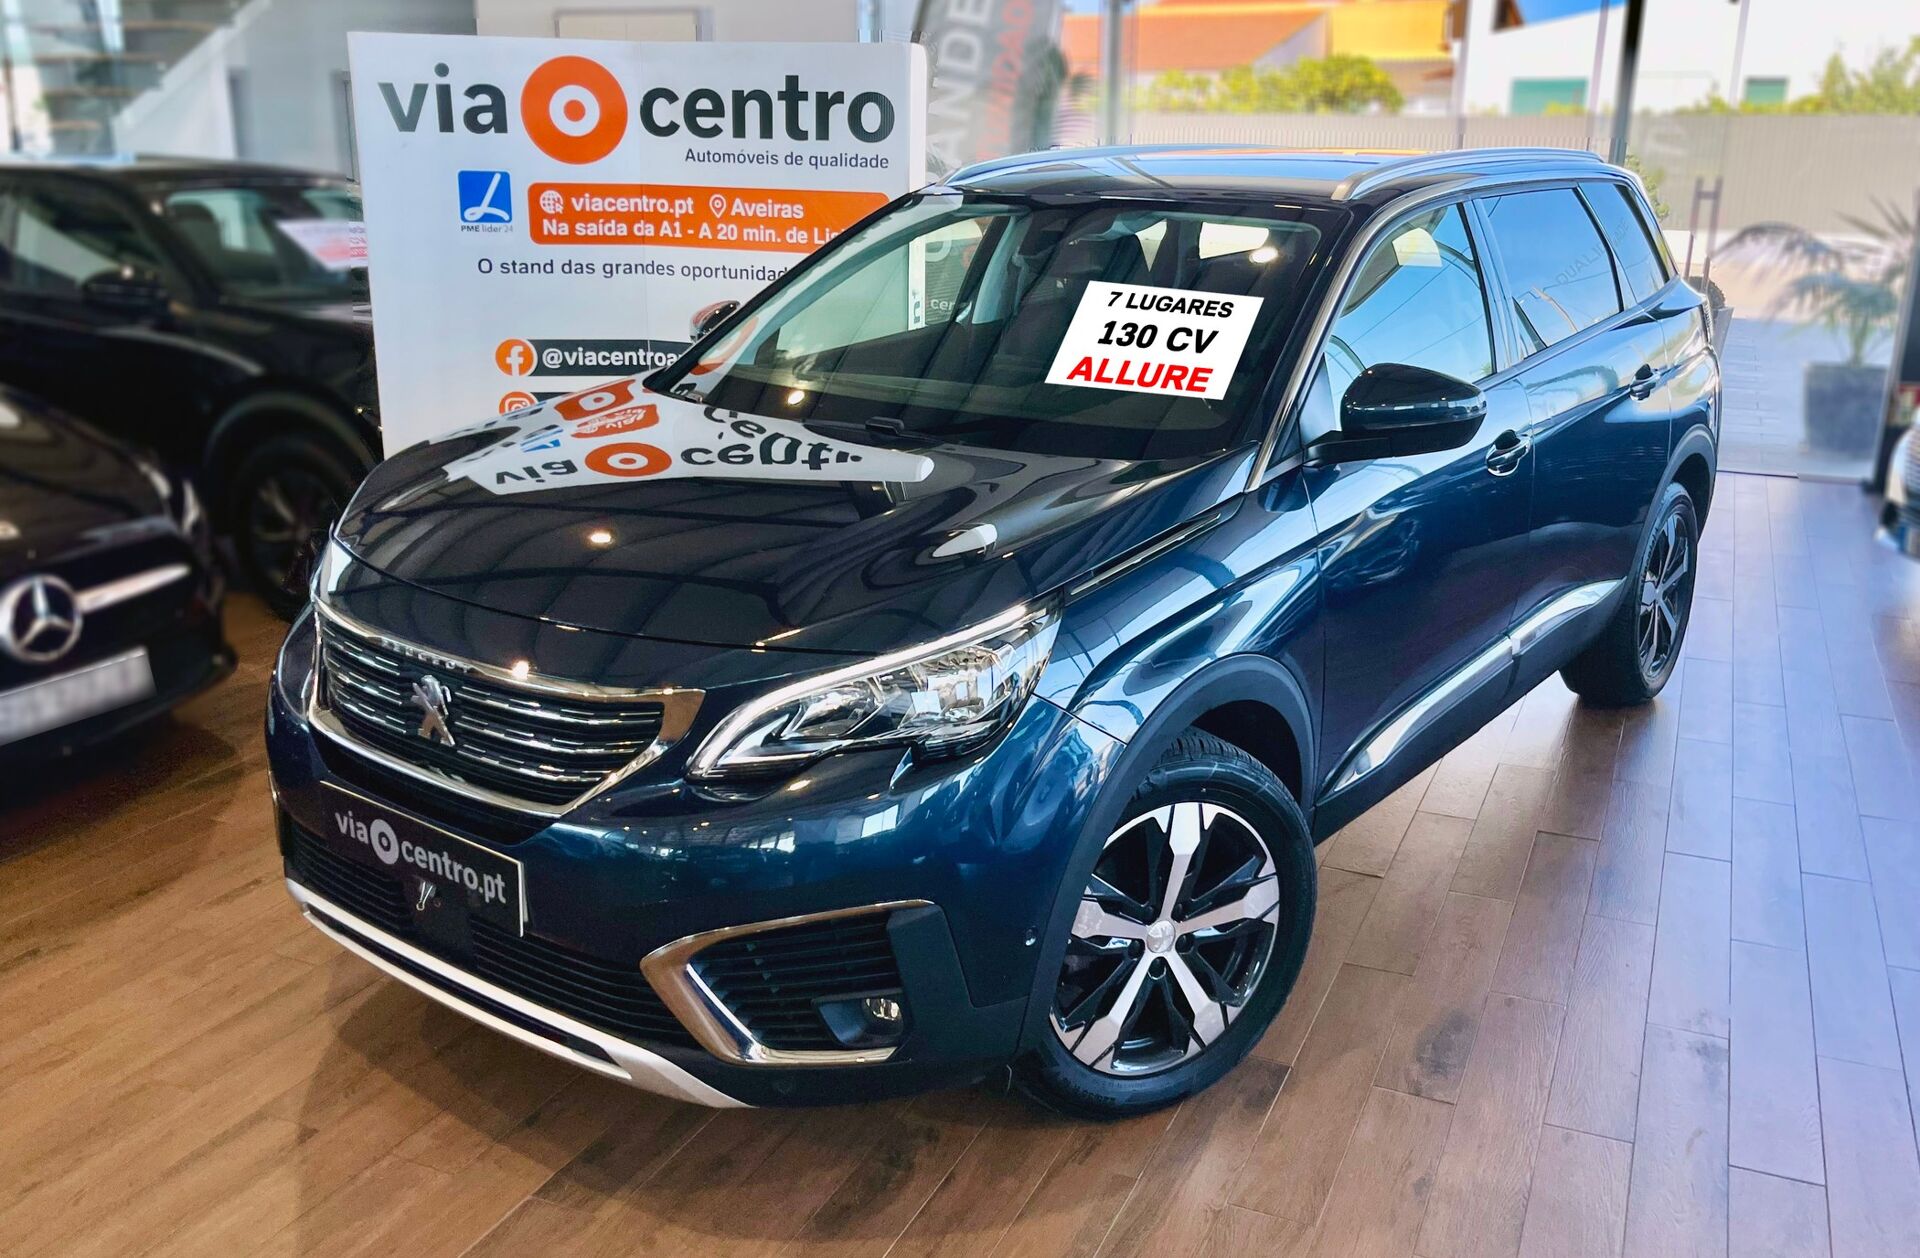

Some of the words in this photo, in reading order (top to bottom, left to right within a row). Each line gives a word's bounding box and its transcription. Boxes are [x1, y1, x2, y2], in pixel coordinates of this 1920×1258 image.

[377, 62, 508, 134] via
[639, 74, 896, 144] centro
[685, 148, 779, 166] Automóveis
[784, 151, 804, 166] de
[808, 153, 889, 170] qualidade
[571, 192, 694, 218] viacentro.pt
[730, 198, 804, 219] Aveiras
[460, 224, 480, 233] PME
[543, 219, 570, 236] Na
[574, 218, 628, 236] saída
[633, 220, 655, 236] da
[659, 221, 682, 238] A1
[699, 223, 713, 240] A
[716, 224, 738, 241] 20
[742, 224, 782, 243] min.
[785, 226, 808, 244] de
[477, 257, 494, 274] O
[500, 259, 554, 275] stand
[561, 259, 595, 275] das
[602, 260, 675, 279] grandes
[542, 346, 682, 369] @viacentroa
[335, 811, 369, 845] via
[401, 840, 507, 904] centro.pt
